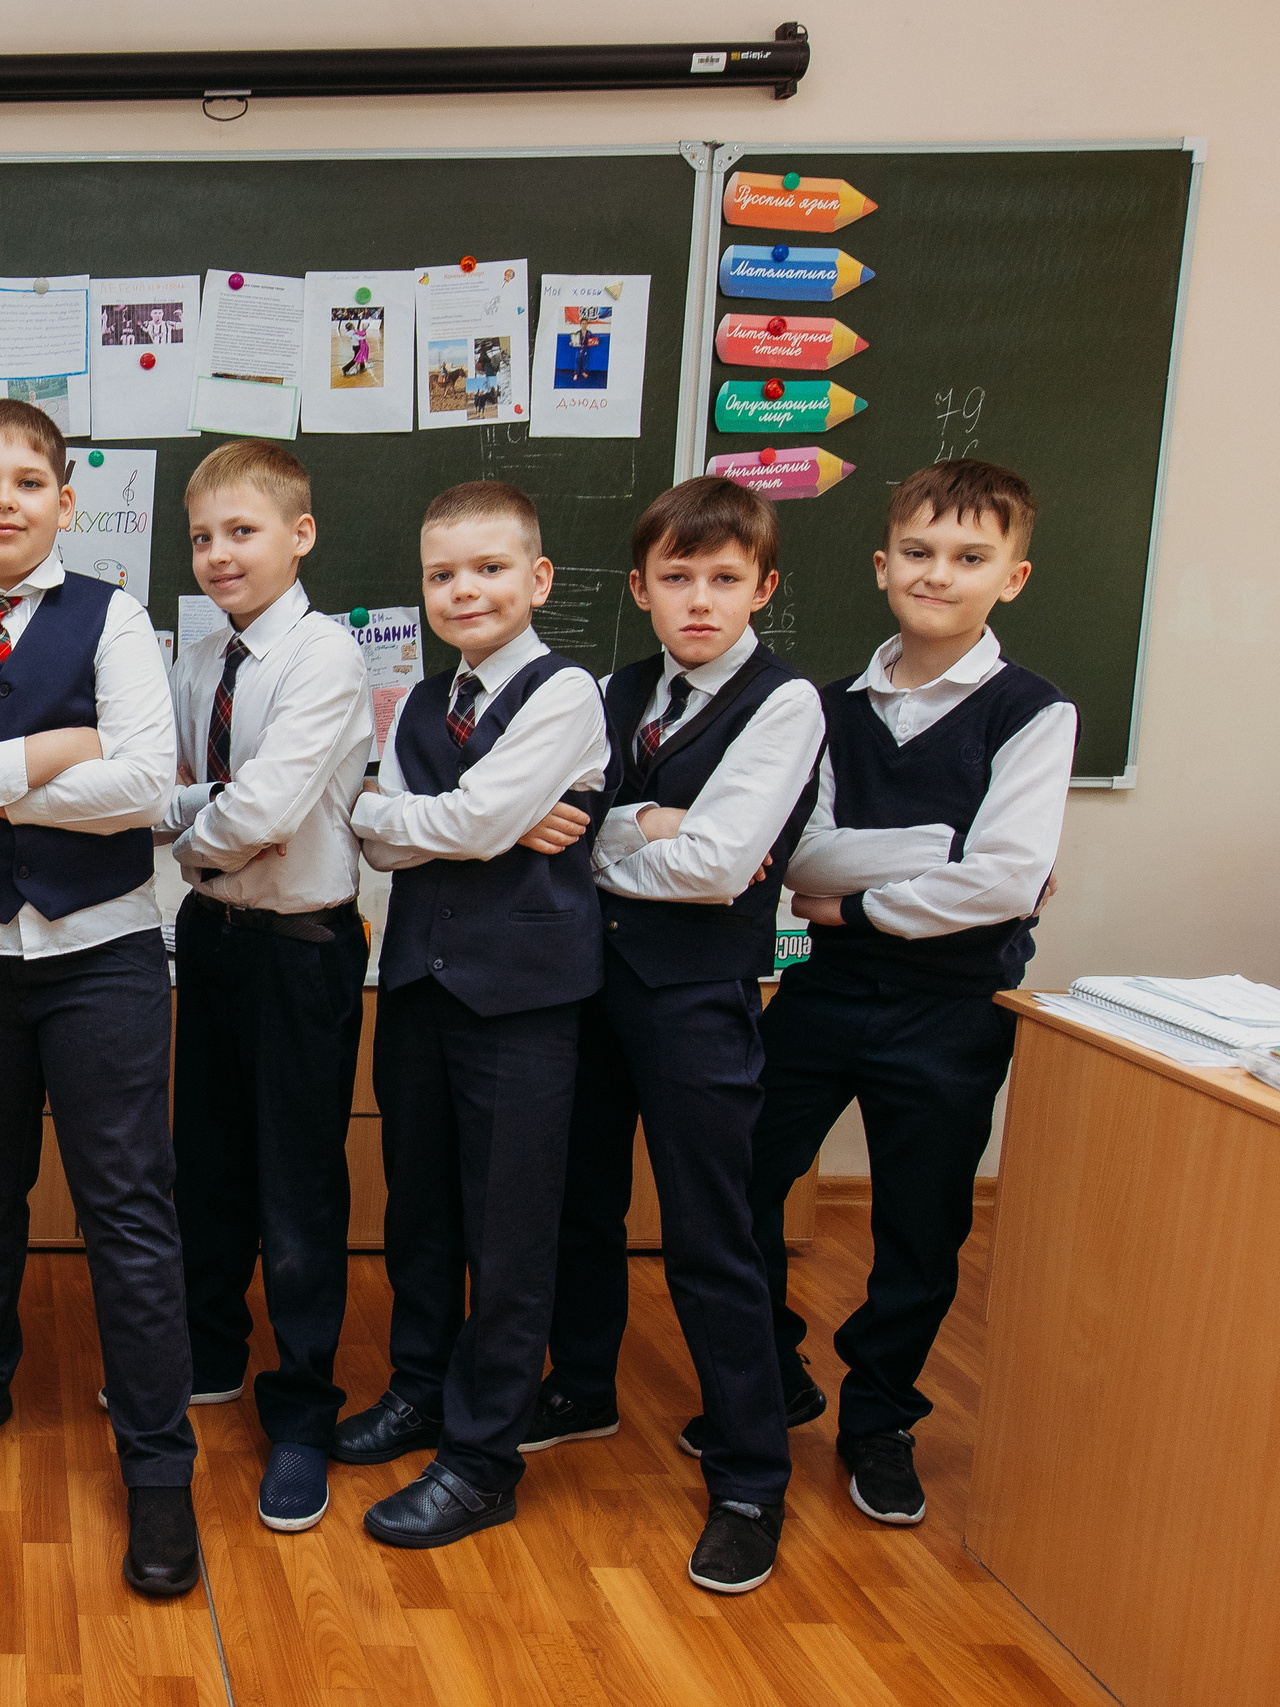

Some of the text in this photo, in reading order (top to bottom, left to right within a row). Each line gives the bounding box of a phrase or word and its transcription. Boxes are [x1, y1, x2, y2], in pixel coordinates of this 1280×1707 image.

[733, 184, 840, 216] Русский язык
[730, 260, 838, 281] Математика
[752, 343, 802, 357] чтение
[555, 398, 608, 410] ДЗЮДО
[726, 394, 830, 417] Окружающий
[935, 386, 986, 435] 79
[758, 410, 793, 428] мир
[723, 460, 811, 478] Английский
[59, 511, 147, 534] КУССТВО
